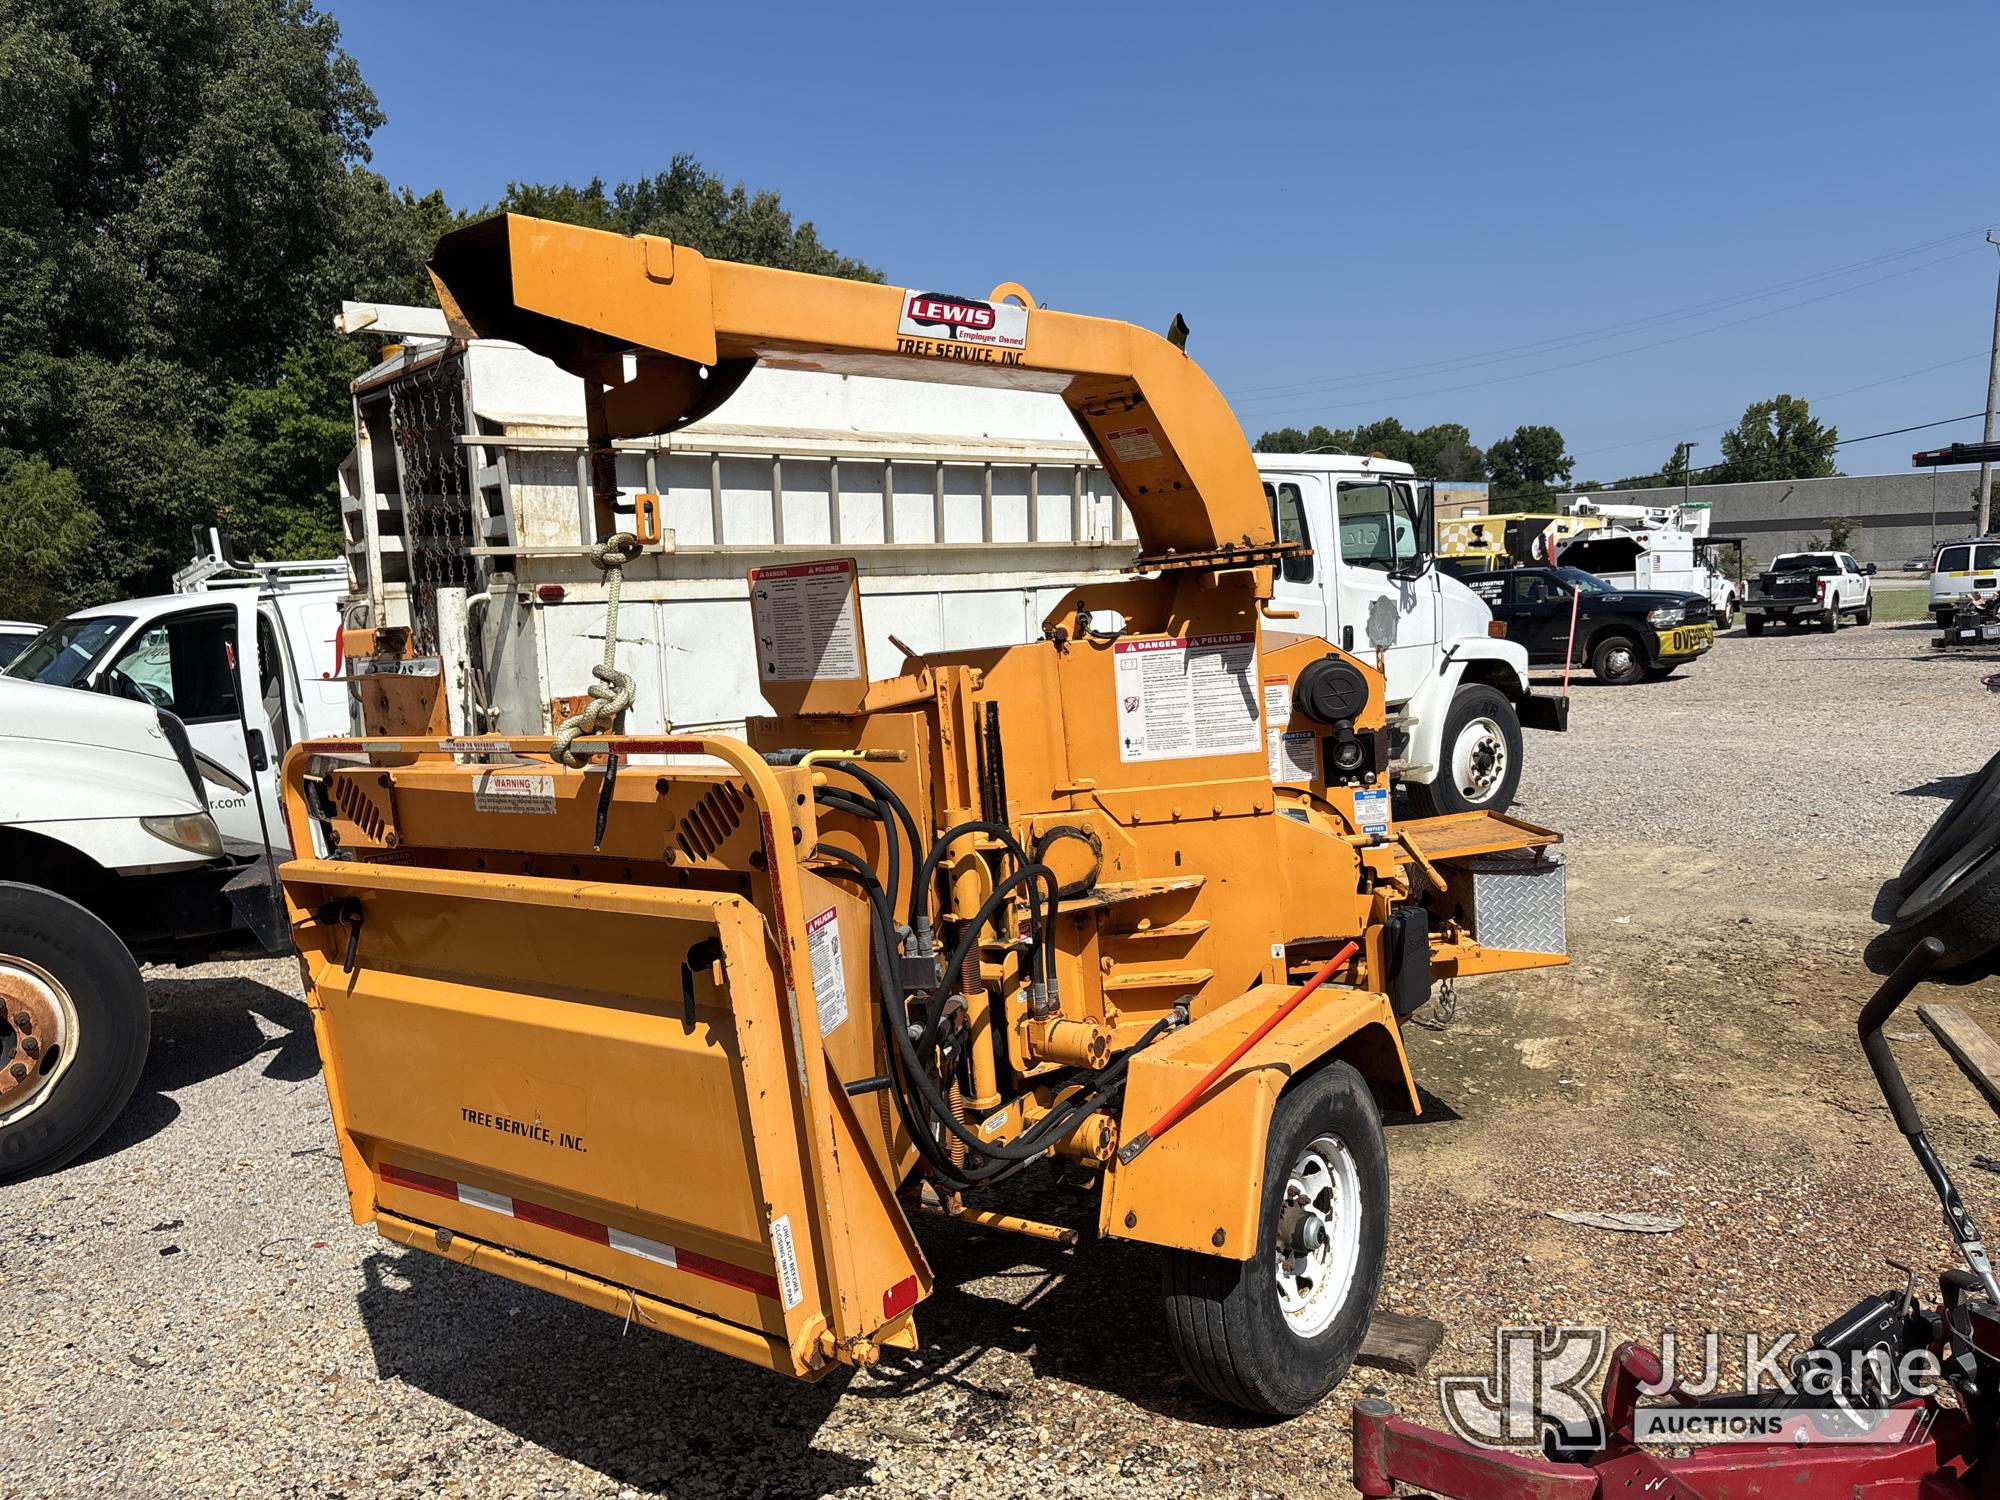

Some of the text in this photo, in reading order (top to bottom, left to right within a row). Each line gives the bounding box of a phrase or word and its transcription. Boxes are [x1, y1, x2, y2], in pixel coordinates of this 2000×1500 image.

[911, 300, 991, 325] LEWIS
[959, 330, 1024, 345] Employee Owned
[897, 338, 1027, 366] TREE SERVICE, INC.
[1138, 640, 1177, 649] DANGER
[1201, 634, 1242, 644] PELIGRO
[494, 779, 531, 788] WARNING
[461, 1107, 588, 1152] TREE SERVICE, INC.
[789, 1262, 799, 1293] BEFORE
